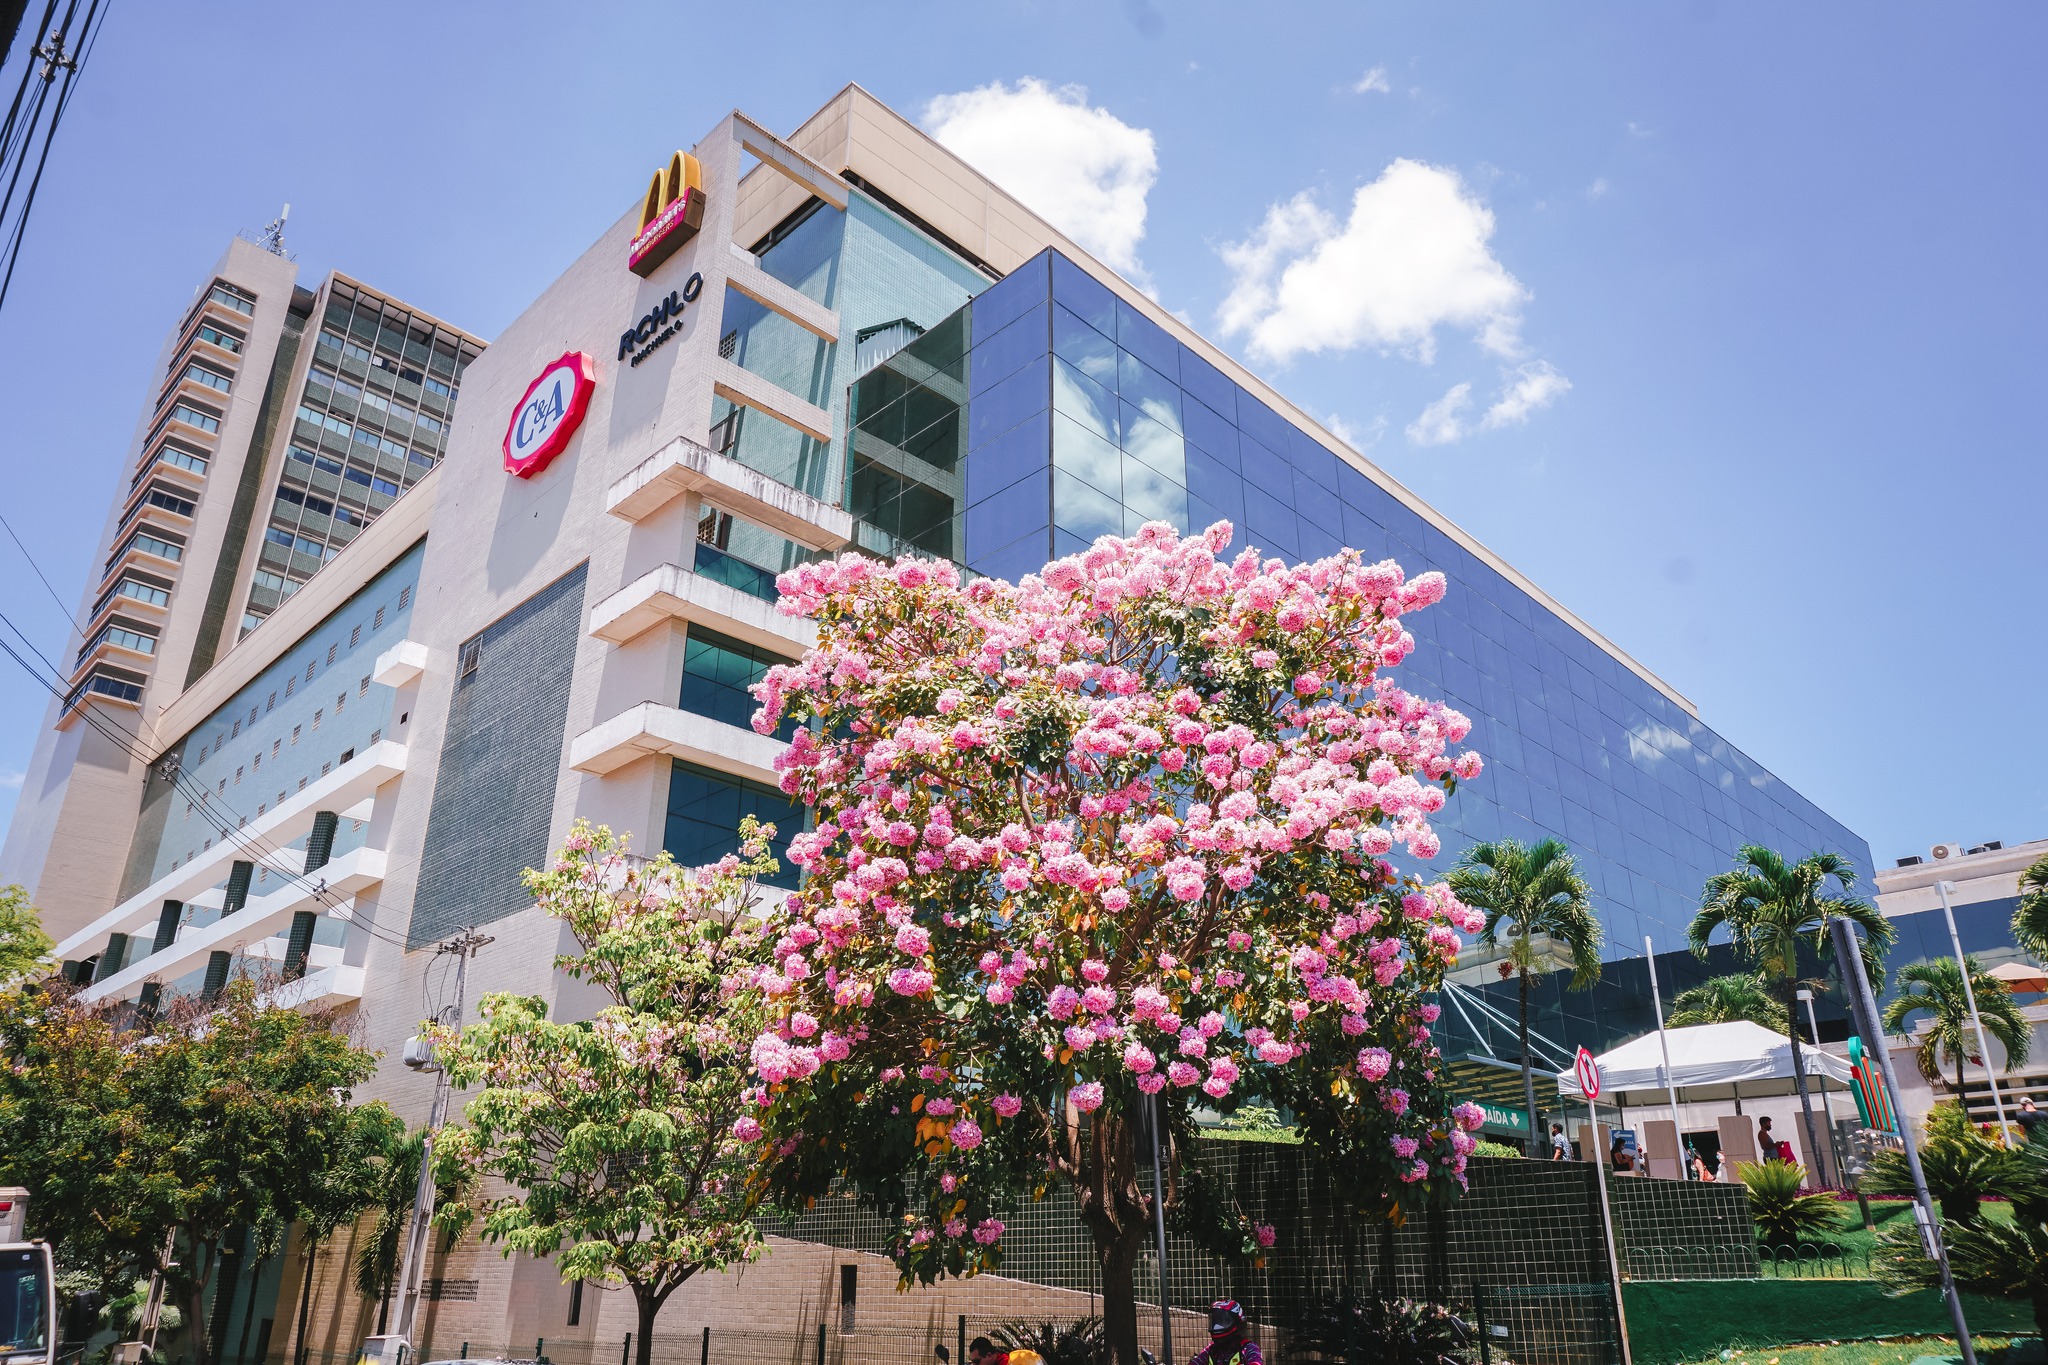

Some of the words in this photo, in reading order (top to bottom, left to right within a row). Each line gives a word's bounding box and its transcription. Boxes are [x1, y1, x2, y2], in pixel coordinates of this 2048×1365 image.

[637, 220, 674, 258] HAMBURGERS
[617, 272, 704, 361] RCHLO
[630, 319, 683, 368] RIACHUELO
[516, 380, 564, 449] C&A
